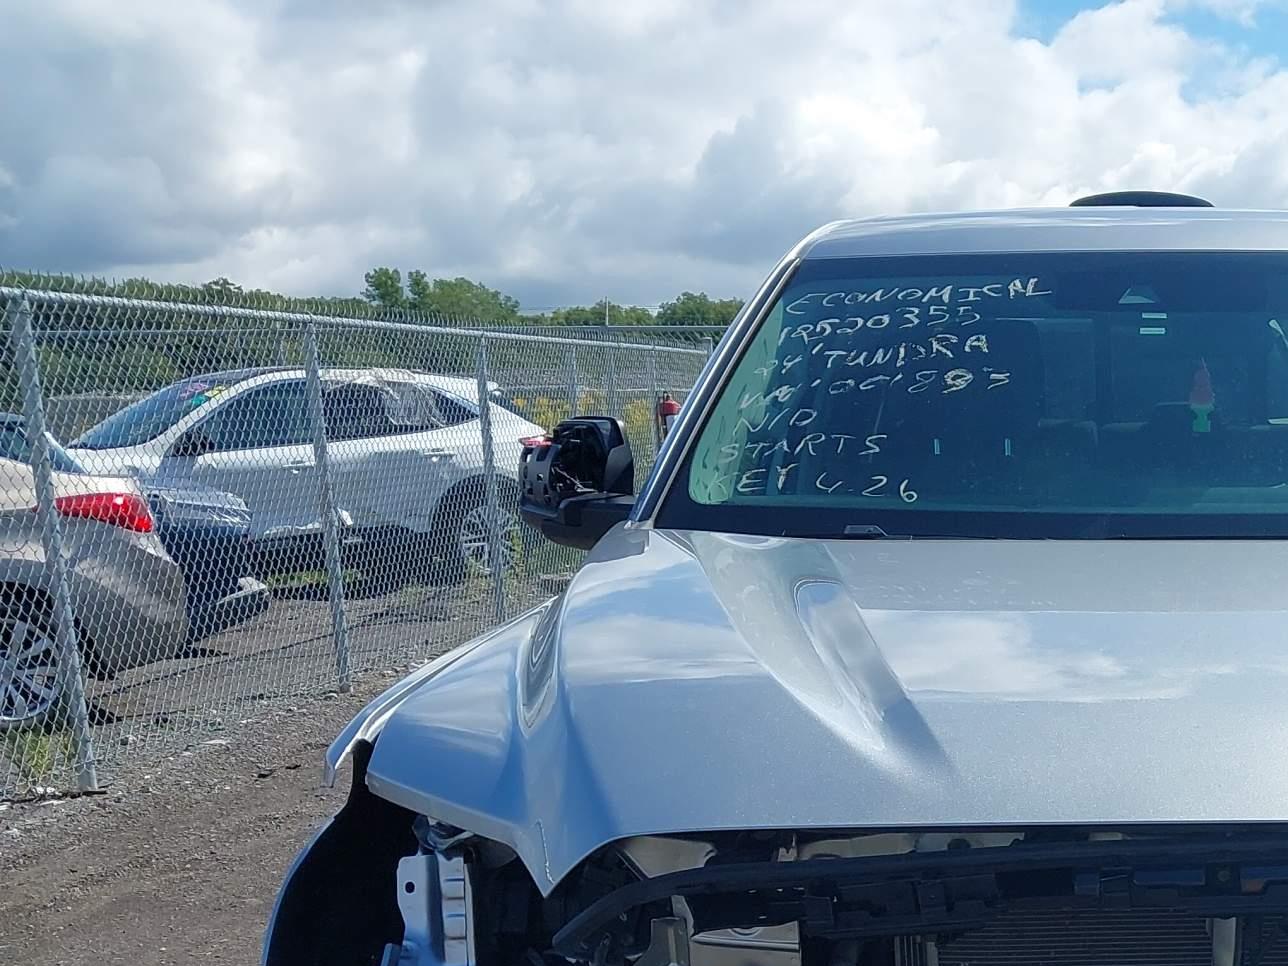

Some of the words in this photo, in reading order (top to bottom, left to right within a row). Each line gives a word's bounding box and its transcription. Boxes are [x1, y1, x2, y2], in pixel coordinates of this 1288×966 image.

[785, 277, 1052, 315] ECONOMICAL
[719, 431, 889, 464] STARTS
[707, 463, 800, 502] KEY
